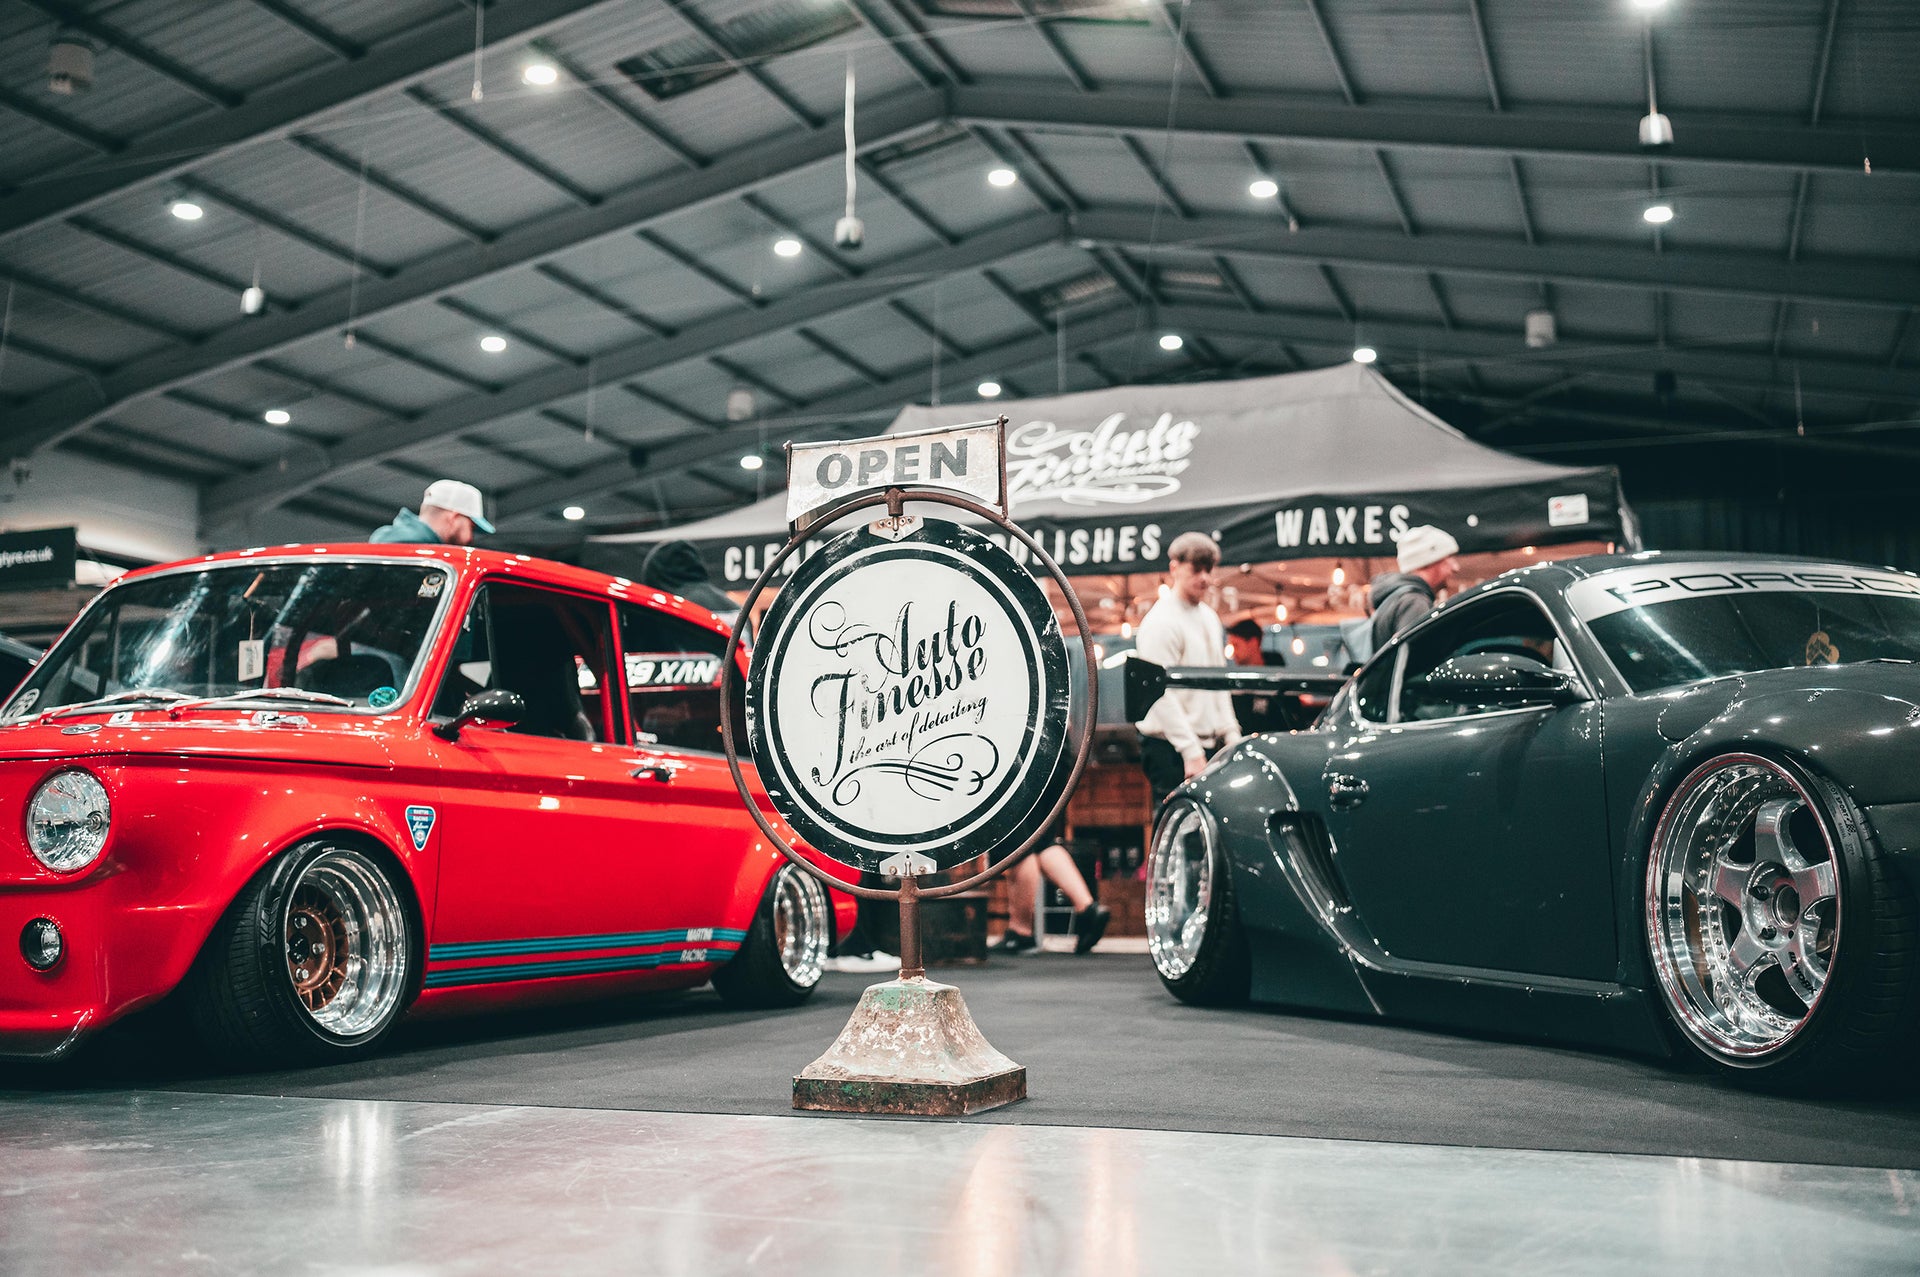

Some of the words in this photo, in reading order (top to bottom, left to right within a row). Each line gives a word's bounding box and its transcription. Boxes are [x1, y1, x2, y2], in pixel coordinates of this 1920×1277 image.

[815, 438, 969, 490] OPEN
[1274, 504, 1411, 548] WAXES
[808, 600, 988, 694] Auto
[810, 646, 989, 787] Finesse
[849, 735, 873, 764] the
[874, 731, 899, 754] art
[900, 711, 920, 755] of
[917, 696, 989, 735] detailing
[1836, 797, 1849, 817] SPORT
[680, 948, 708, 963] RACING
